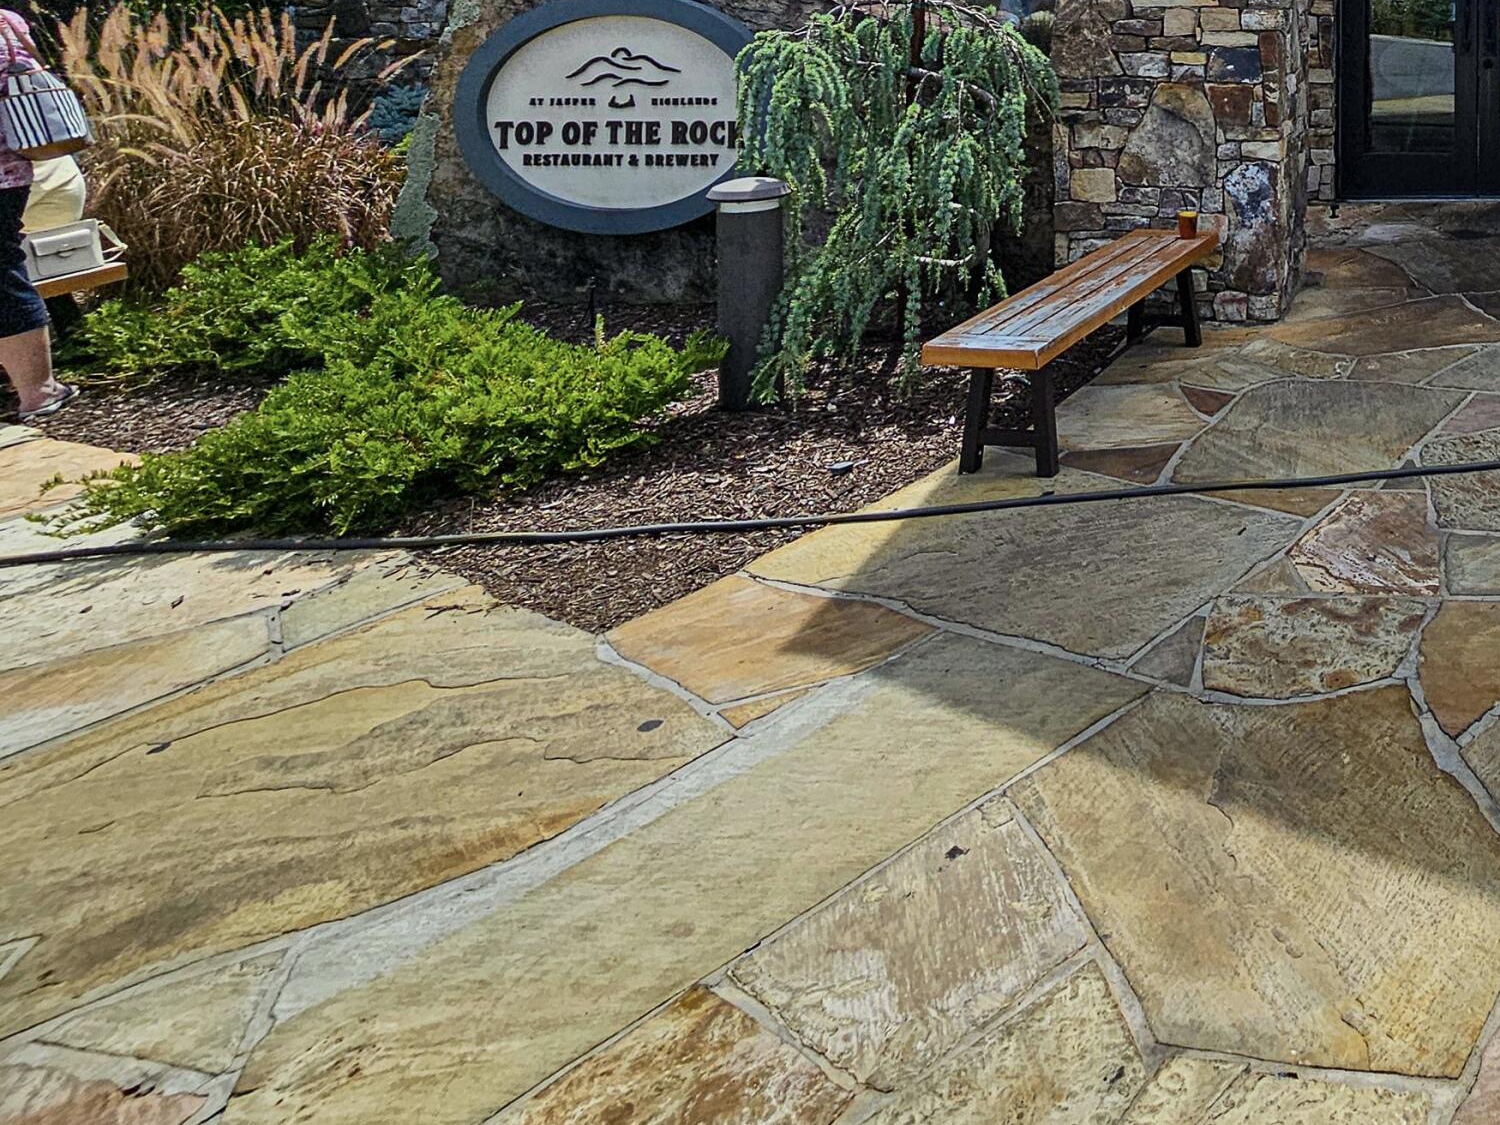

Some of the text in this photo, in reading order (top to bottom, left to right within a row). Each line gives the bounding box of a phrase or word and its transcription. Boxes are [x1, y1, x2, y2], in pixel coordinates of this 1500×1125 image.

[529, 97, 544, 106] AT
[494, 121, 554, 150] TOP
[561, 121, 598, 145] OF
[605, 120, 662, 146] THE
[522, 153, 720, 167] RESTAURANT & BREWERY
